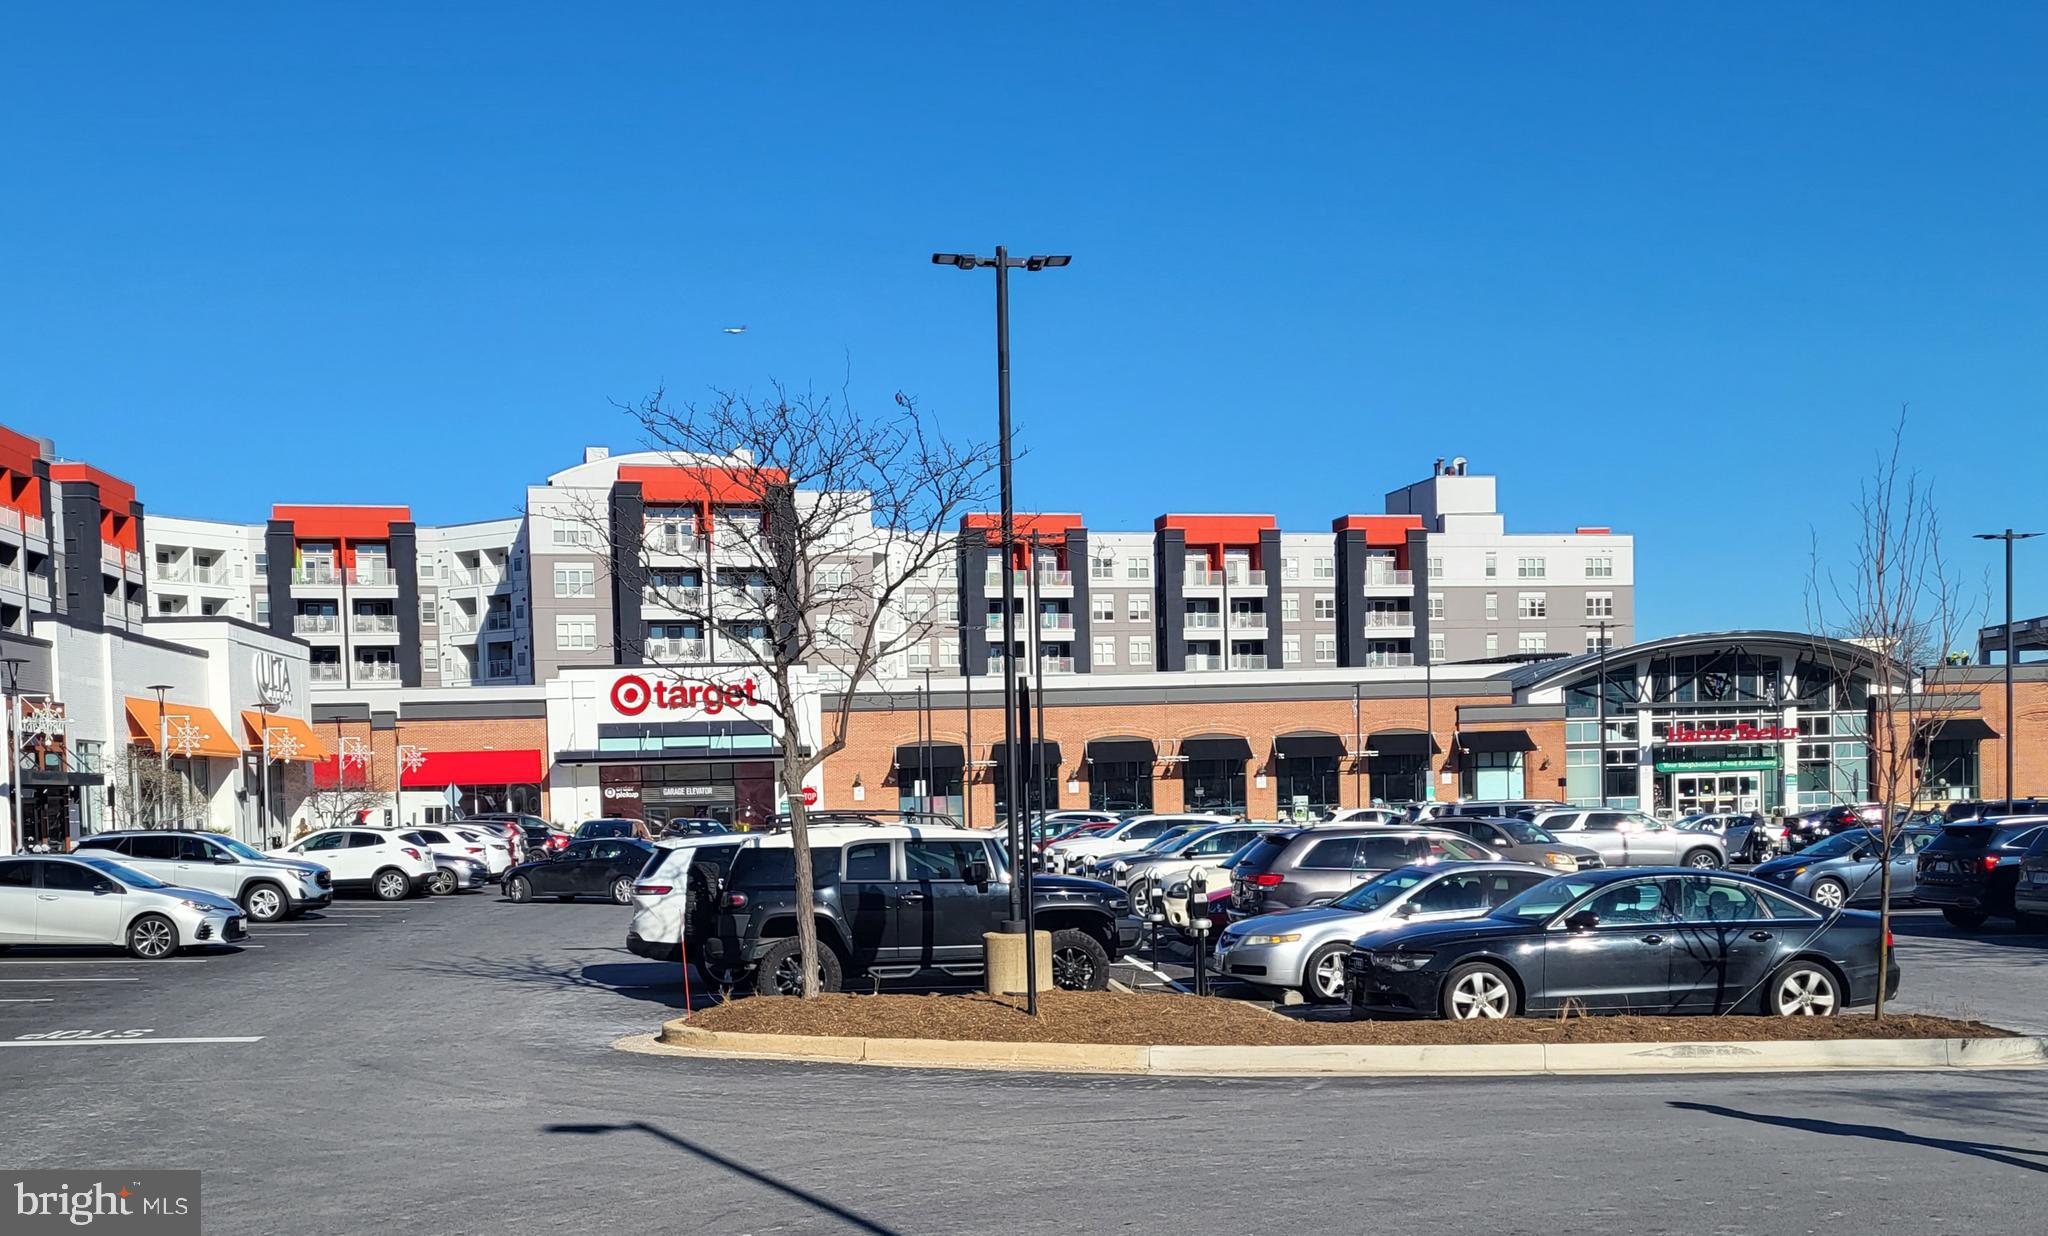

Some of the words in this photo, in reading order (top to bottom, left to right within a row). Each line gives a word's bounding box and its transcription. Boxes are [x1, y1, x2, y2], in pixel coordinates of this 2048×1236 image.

[259, 652, 292, 693] ULTA
[653, 678, 758, 715] target
[1666, 724, 1734, 742] Harris
[1735, 723, 1800, 740] Teeter
[616, 791, 640, 800] pickup
[663, 786, 686, 796] GARAGE
[686, 786, 713, 796] ELEVATOR
[803, 792, 817, 801] TOP
[15, 1029, 155, 1040] STOP
